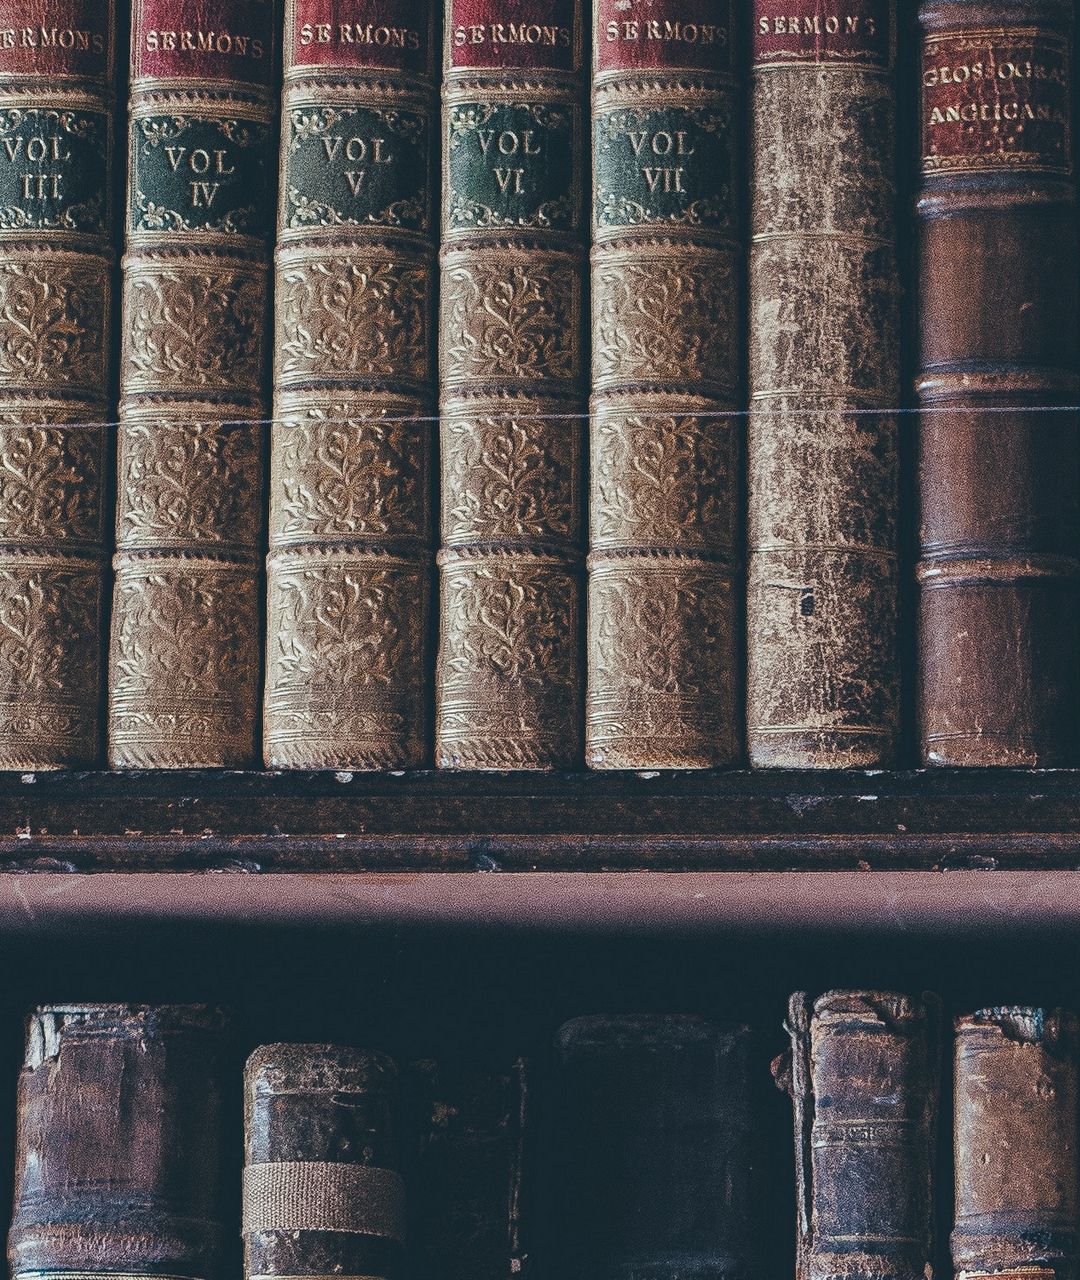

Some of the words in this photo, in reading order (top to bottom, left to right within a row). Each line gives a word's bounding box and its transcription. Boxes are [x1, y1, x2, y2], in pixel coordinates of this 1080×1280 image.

[300, 23, 420, 50] SERMONS
[454, 22, 570, 49] SERMONS
[606, 20, 728, 46] SERMONS
[759, 15, 876, 35] SERMONS
[146, 29, 263, 60] SERMONS
[1, 135, 71, 162] VOL
[321, 136, 391, 164] VOL
[478, 129, 541, 156] VOL
[626, 130, 695, 156] VOL
[164, 146, 235, 175] VOL
[188, 180, 221, 208] IV
[344, 170, 364, 197] V
